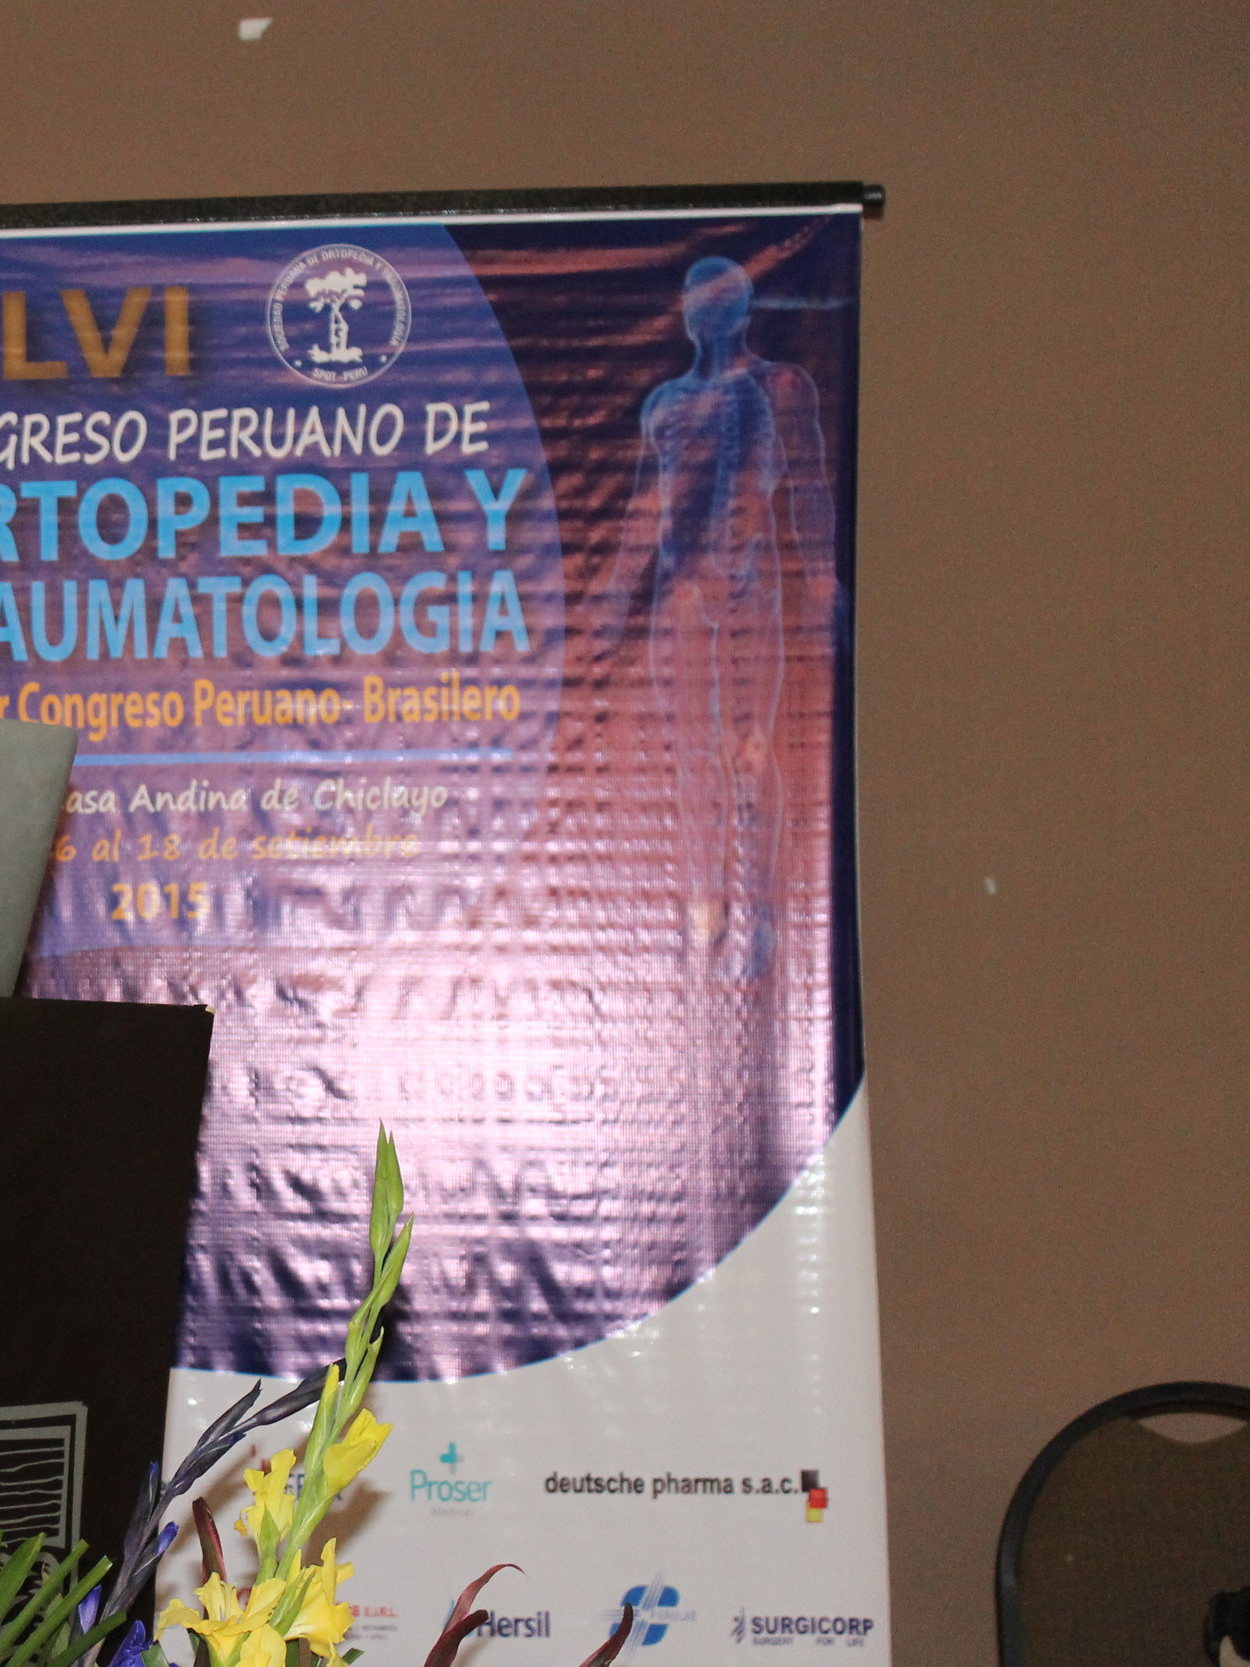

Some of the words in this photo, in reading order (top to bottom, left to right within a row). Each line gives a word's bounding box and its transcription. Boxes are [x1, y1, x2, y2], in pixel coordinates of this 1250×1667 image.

[312, 367, 336, 382] SPOT
[343, 366, 369, 382] PERU
[168, 404, 405, 461] PERUANO
[424, 401, 490, 455] DE
[463, 469, 528, 551] Y
[18, 682, 184, 742] Congreso
[363, 671, 521, 723] Brasilero
[62, 788, 116, 815] asa
[128, 779, 249, 814] Andina
[260, 778, 299, 811] de
[313, 775, 448, 817] Chiclayo
[53, 833, 78, 863] 6
[91, 828, 122, 862] al
[136, 832, 182, 862] 18
[199, 826, 239, 860] de
[251, 824, 420, 861] setiembre
[110, 881, 211, 920] 2015
[410, 1468, 493, 1502] Proser
[545, 1471, 646, 1495] deutsche
[652, 1471, 734, 1499] pharma
[741, 1476, 800, 1495] s.a.c.
[477, 1610, 551, 1638] Hersil
[751, 1615, 875, 1636] SURGICORP
